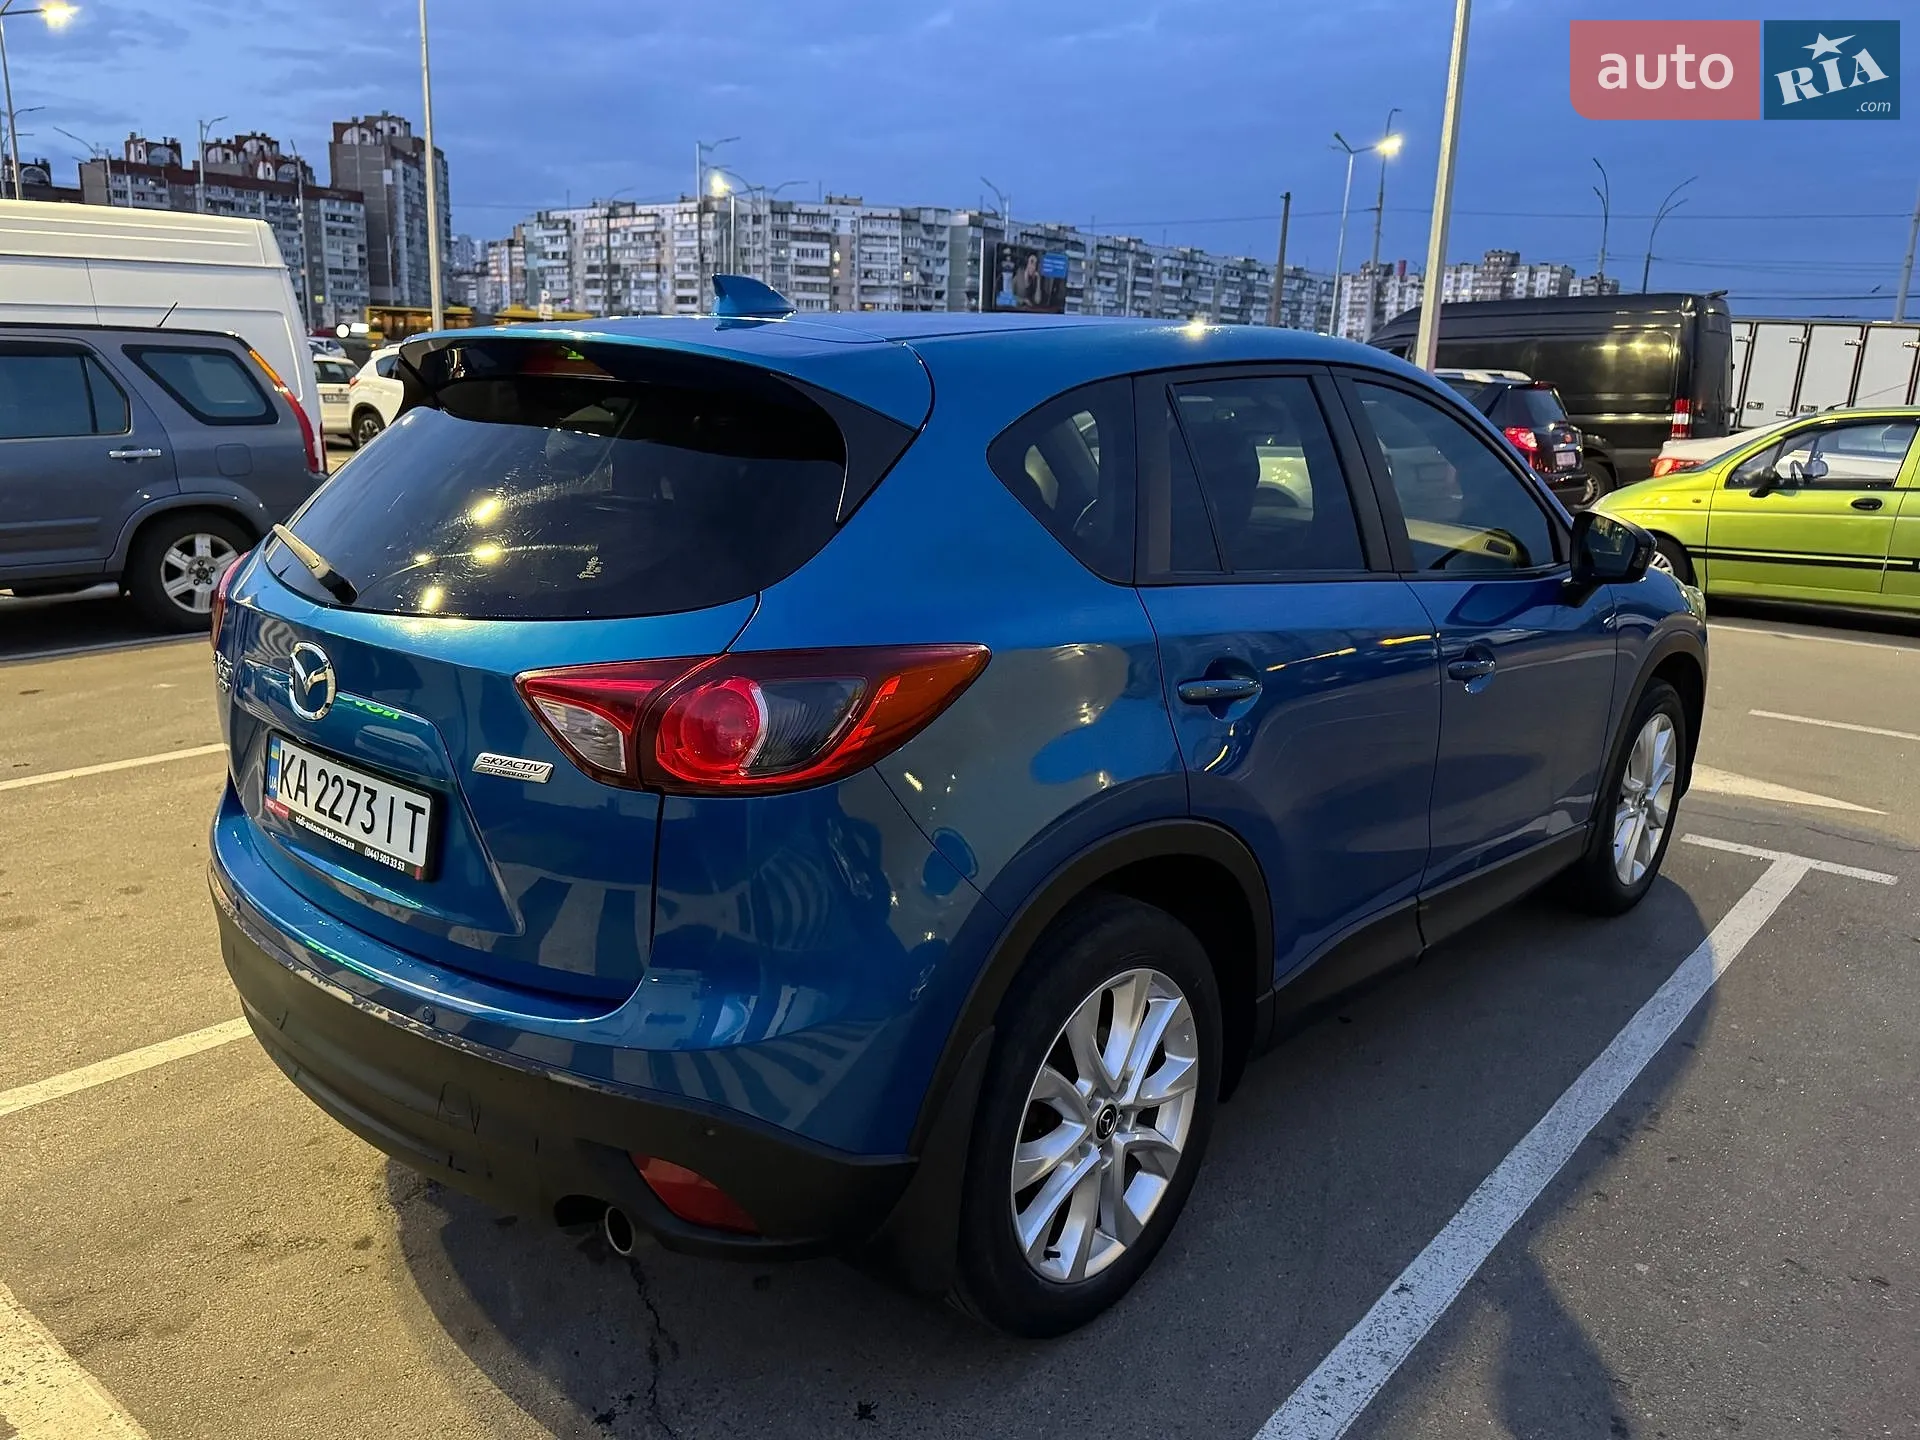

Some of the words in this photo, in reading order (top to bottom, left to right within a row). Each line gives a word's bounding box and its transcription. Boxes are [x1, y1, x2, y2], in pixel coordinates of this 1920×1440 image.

[480, 756, 544, 772] SKYACTIV
[268, 775, 277, 792] UA
[279, 749, 308, 808] KA
[314, 768, 378, 835] 2273
[386, 796, 426, 853] IT
